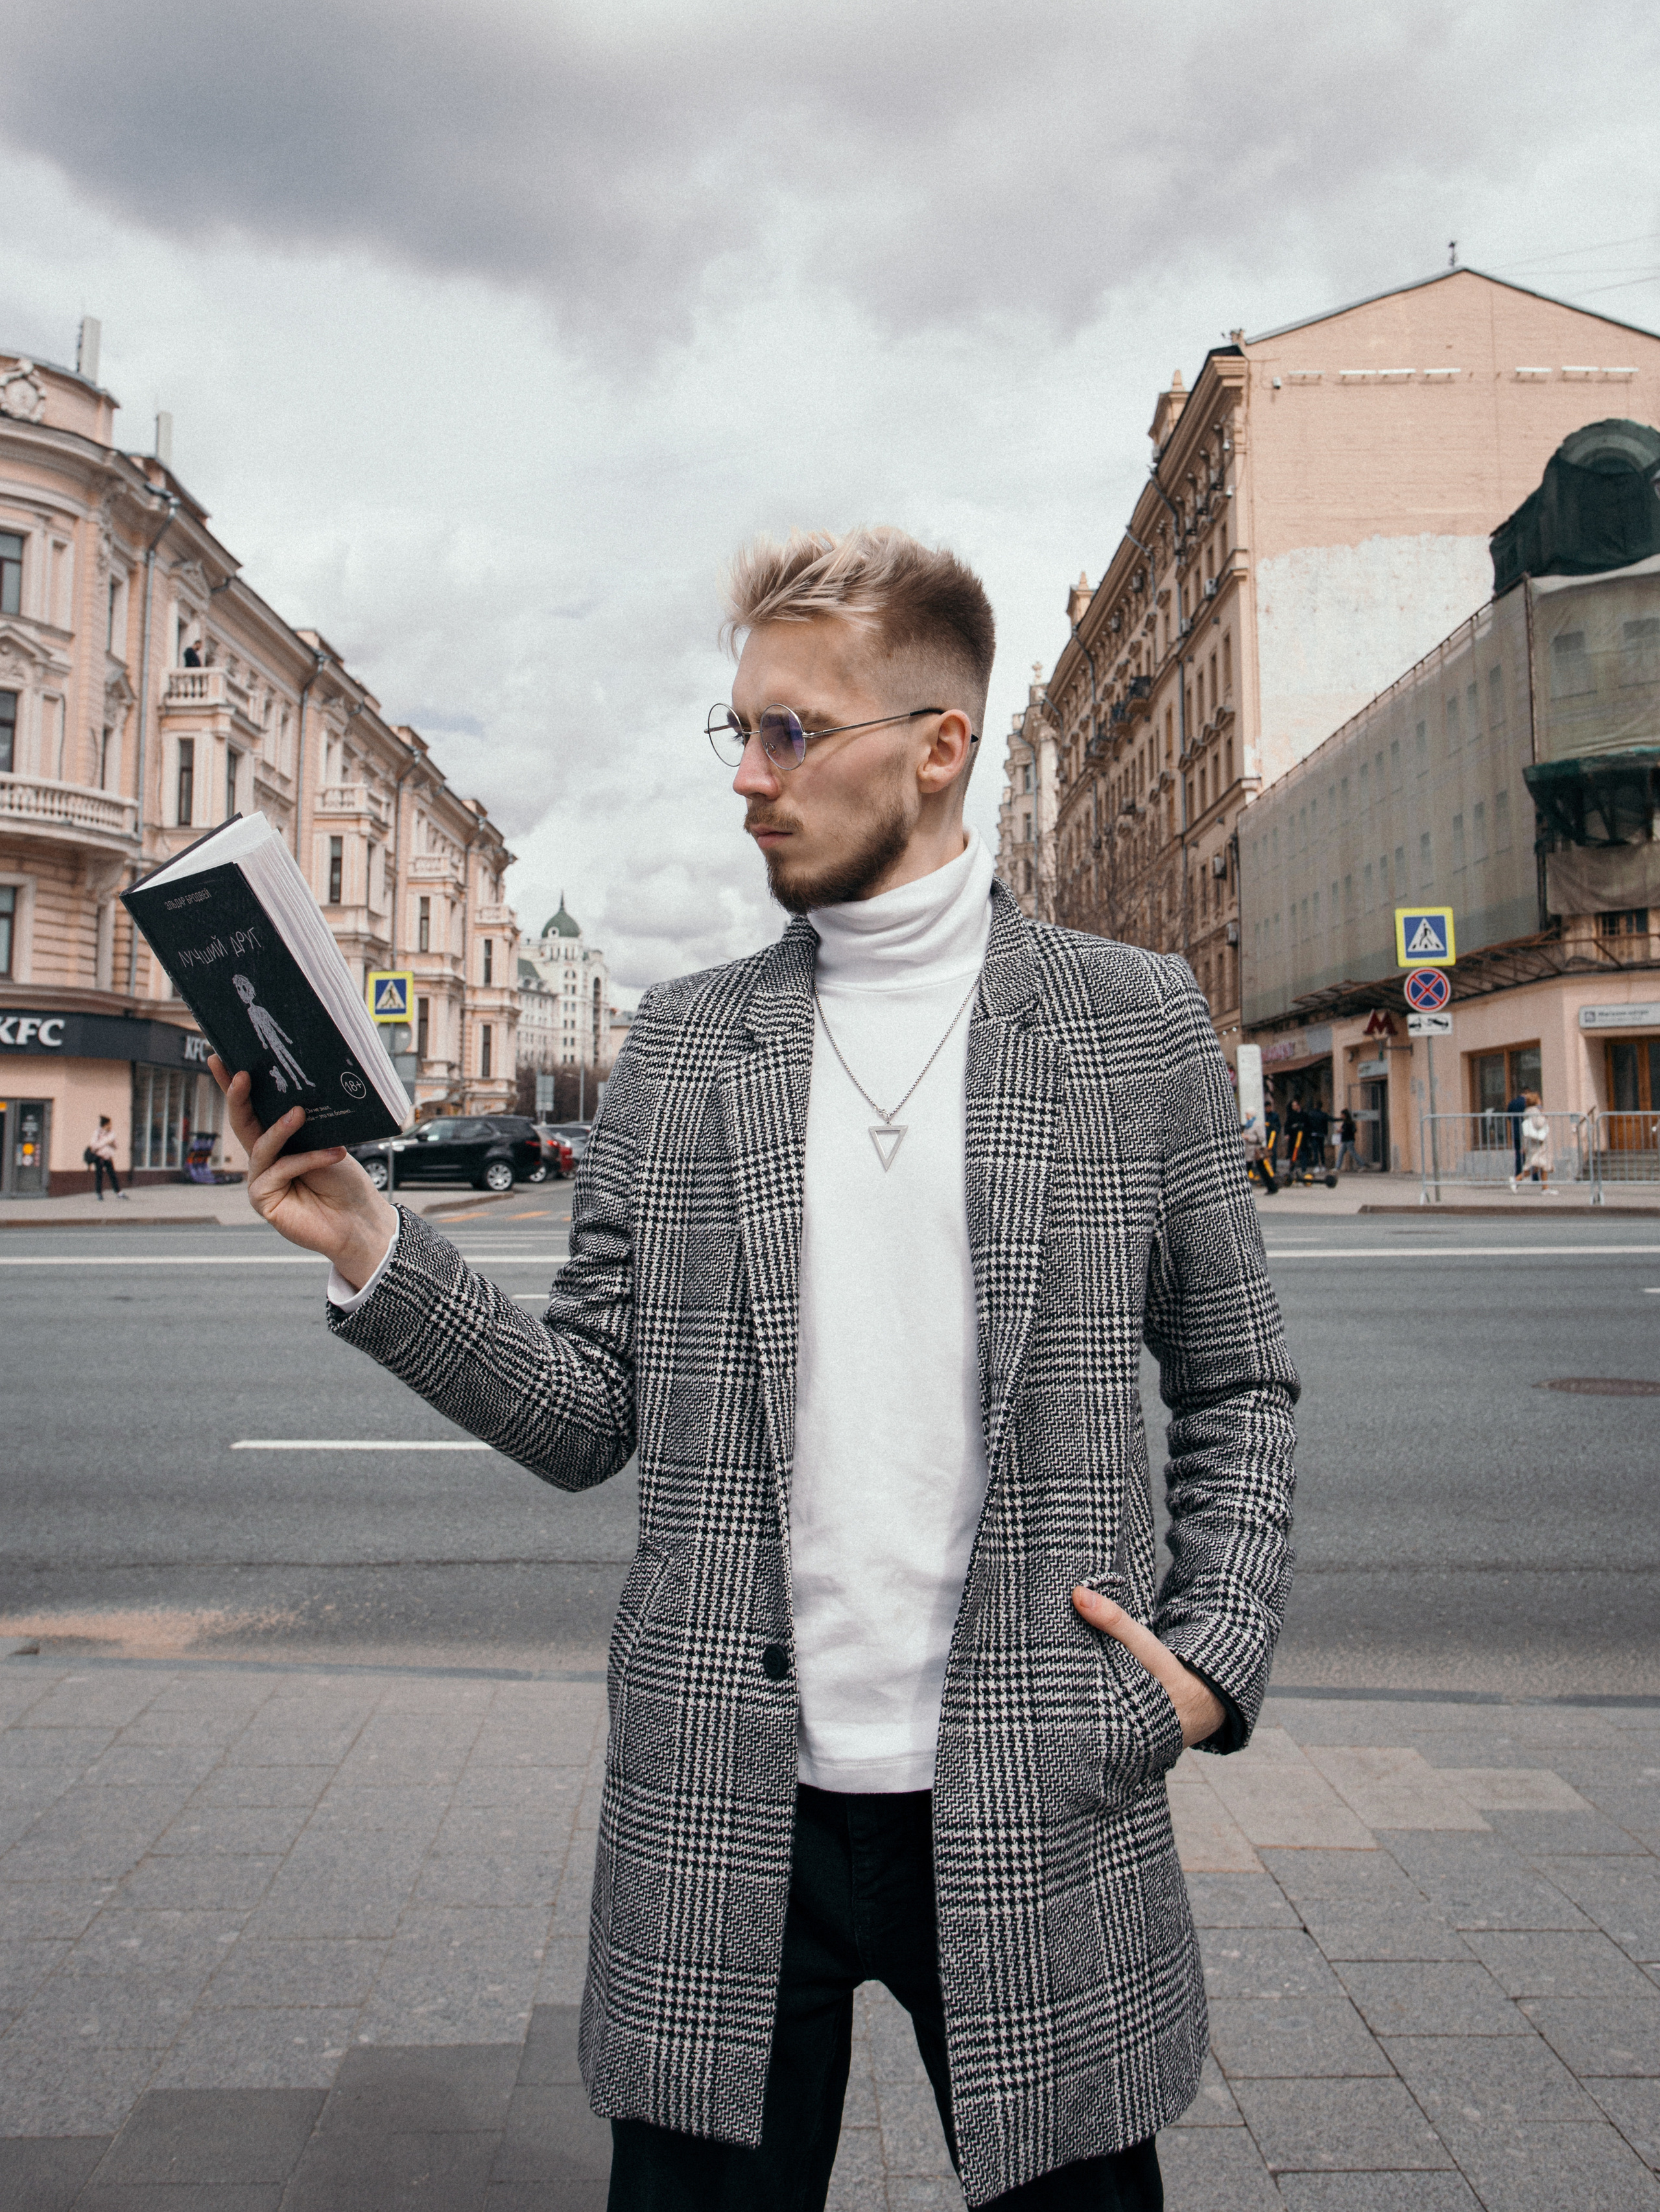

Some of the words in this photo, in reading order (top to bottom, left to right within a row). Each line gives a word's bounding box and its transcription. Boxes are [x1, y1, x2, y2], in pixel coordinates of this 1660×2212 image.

[164, 897, 186, 910] ЭЛЬДАР
[185, 888, 212, 904] БРОДВЕЙ
[178, 935, 229, 968] ЛУЧШИЙ
[230, 926, 262, 957] ДРУГ
[0, 1016, 65, 1047] KFC
[184, 1035, 207, 1063] KFC
[344, 1080, 362, 1092] 18+
